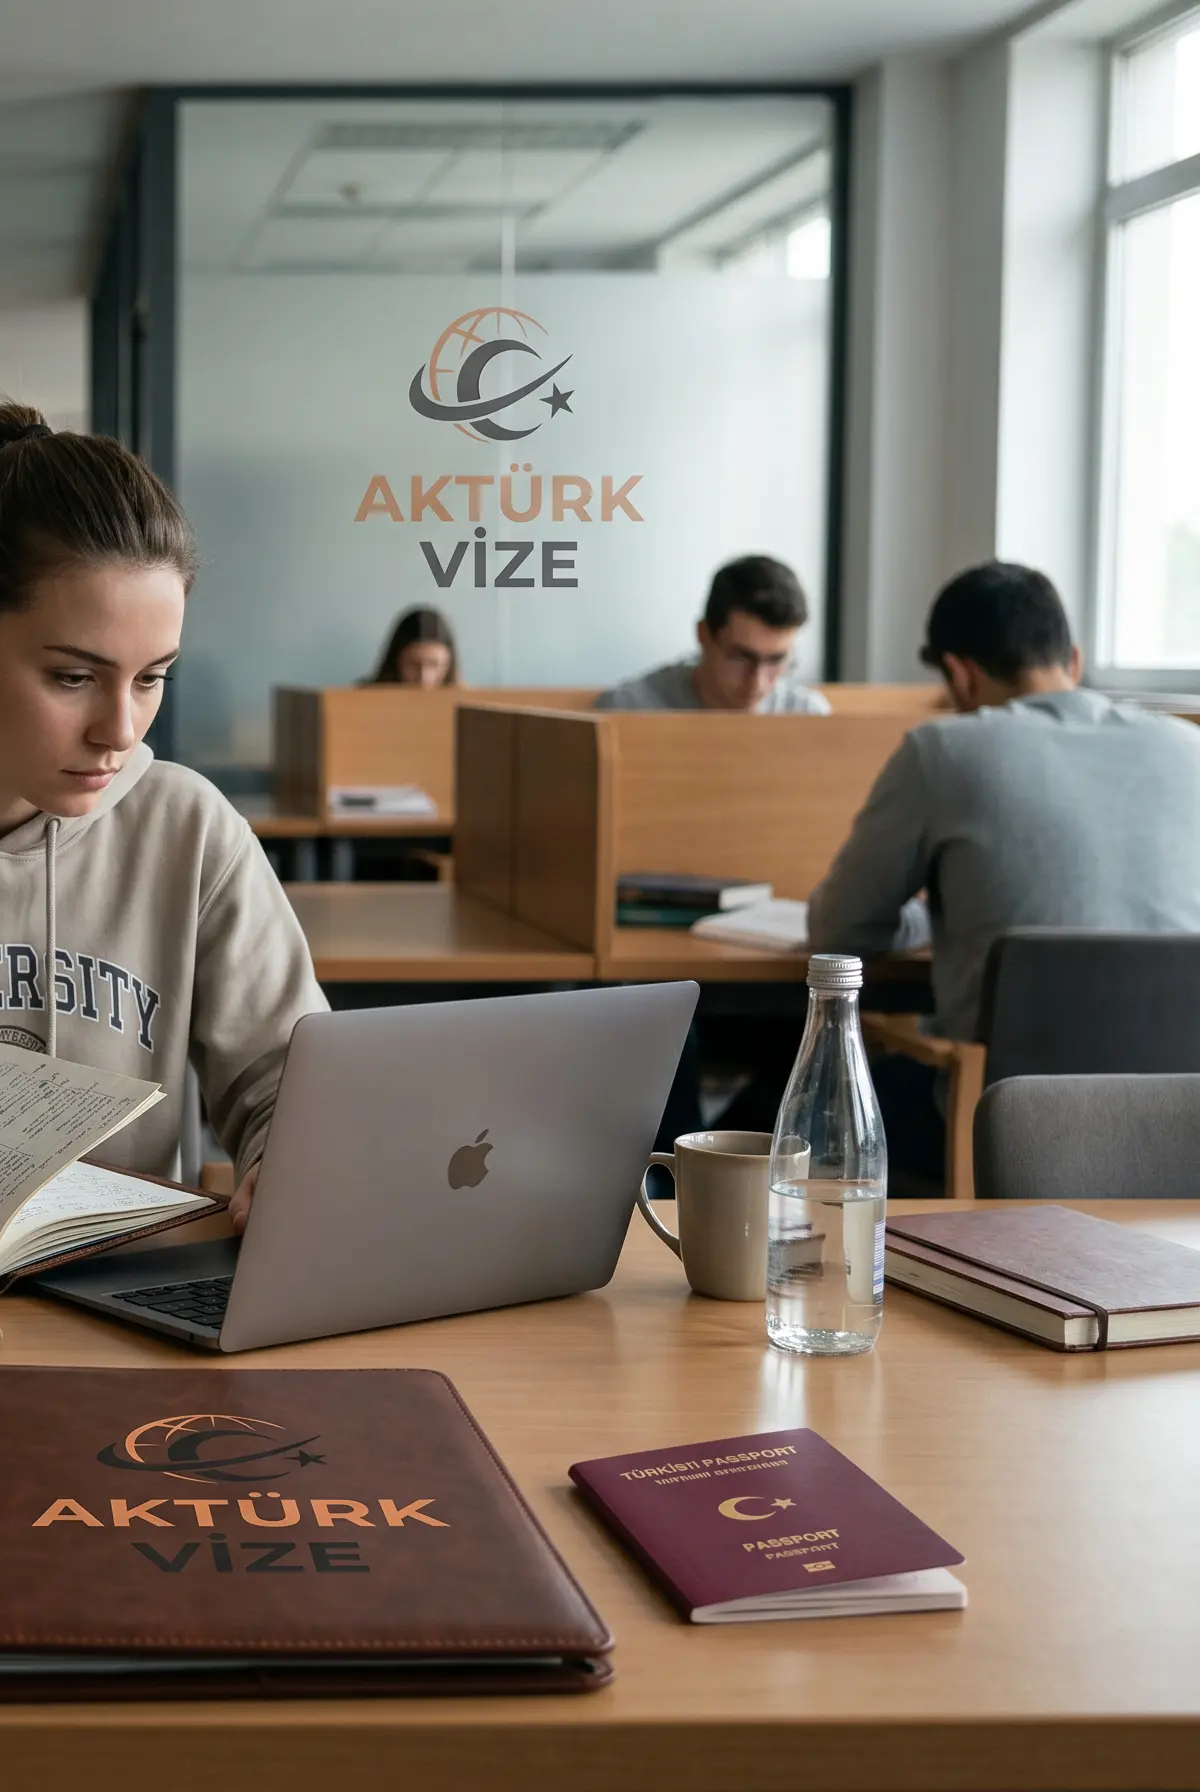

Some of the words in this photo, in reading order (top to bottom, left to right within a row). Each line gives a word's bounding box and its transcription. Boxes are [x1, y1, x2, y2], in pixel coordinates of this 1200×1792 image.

[353, 462, 646, 523] AKTÜRK
[418, 526, 579, 589] VİZE
[701, 1445, 798, 1468] PASSPORT
[31, 1491, 452, 1528] AKTÜRK
[130, 1532, 371, 1574] VİZE
[742, 1528, 841, 1553] PASSPORT
